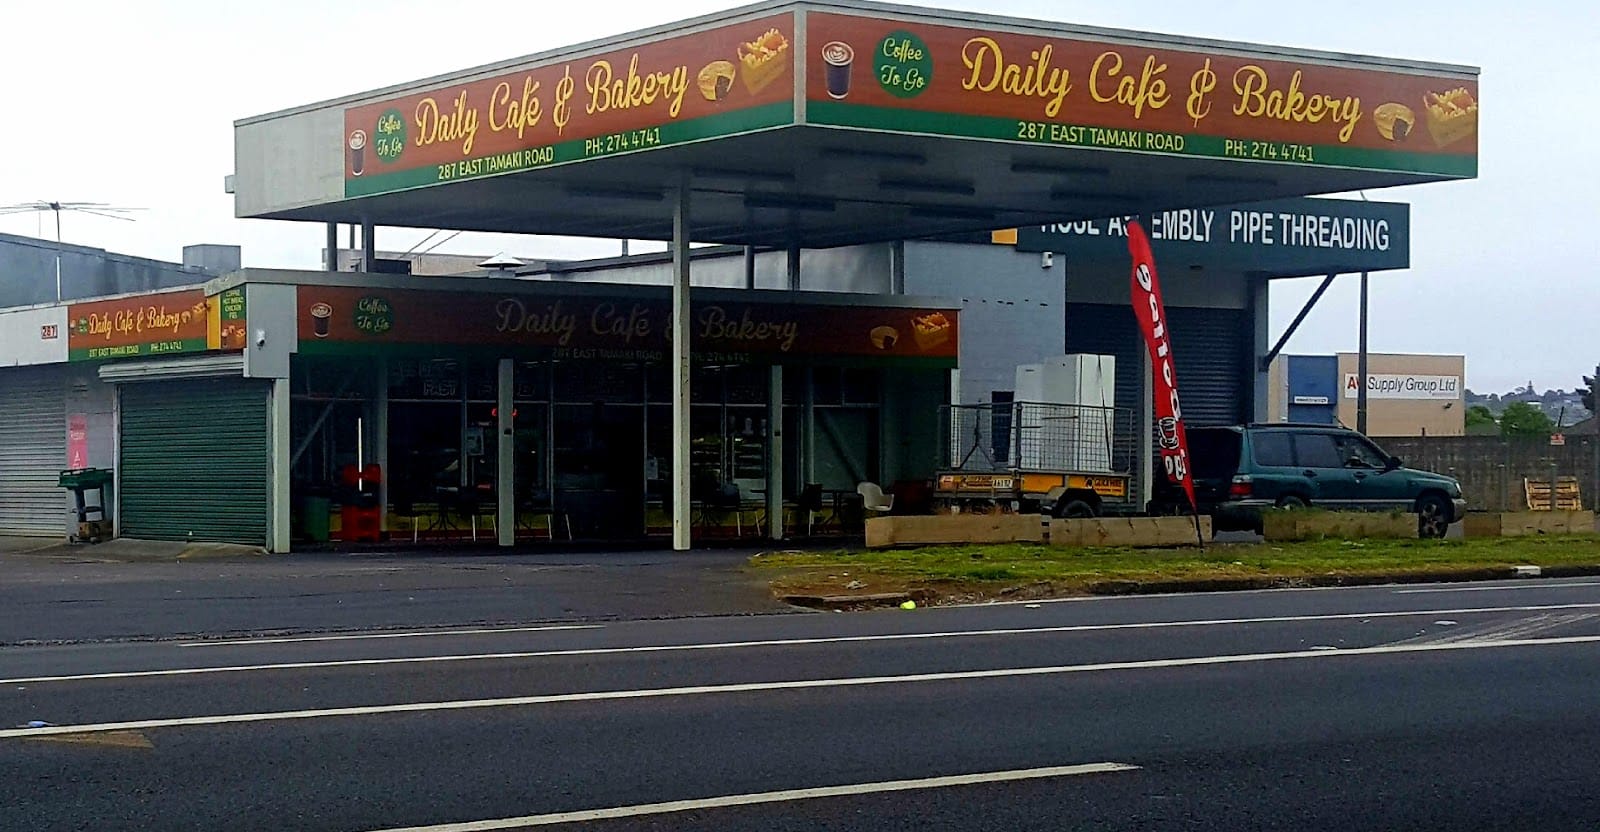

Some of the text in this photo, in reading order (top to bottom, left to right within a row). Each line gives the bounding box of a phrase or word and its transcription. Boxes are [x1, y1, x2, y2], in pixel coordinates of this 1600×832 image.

[883, 38, 923, 63] Coffee
[881, 65, 925, 91] To Go
[961, 37, 1363, 142] Daily Café & Bakery
[415, 53, 690, 155] Daily Café & Bakery
[378, 114, 401, 135] Coffee
[377, 137, 403, 157] To Go
[438, 127, 661, 180] 287 EAST TAMAKI ROAD PH: 274 4741
[1018, 121, 1314, 163] 287 EAST TAMAKI ROAD PH: 274 4741
[1108, 210, 1215, 242] AEMBLY
[1230, 210, 1274, 244] PIPE
[1279, 212, 1390, 251] THREADING
[359, 299, 388, 314] Coffee
[89, 313, 112, 339] Daily
[115, 309, 134, 335] Café
[147, 305, 180, 333] Bakery
[357, 315, 389, 331] To Go
[495, 298, 576, 347] Daily
[592, 301, 650, 344] Café
[699, 303, 798, 351] Bakery
[573, 347, 597, 360] EAST
[1367, 376, 1403, 393] Supply
[1405, 377, 1438, 392] Group
[1439, 378, 1456, 392] Ltd
